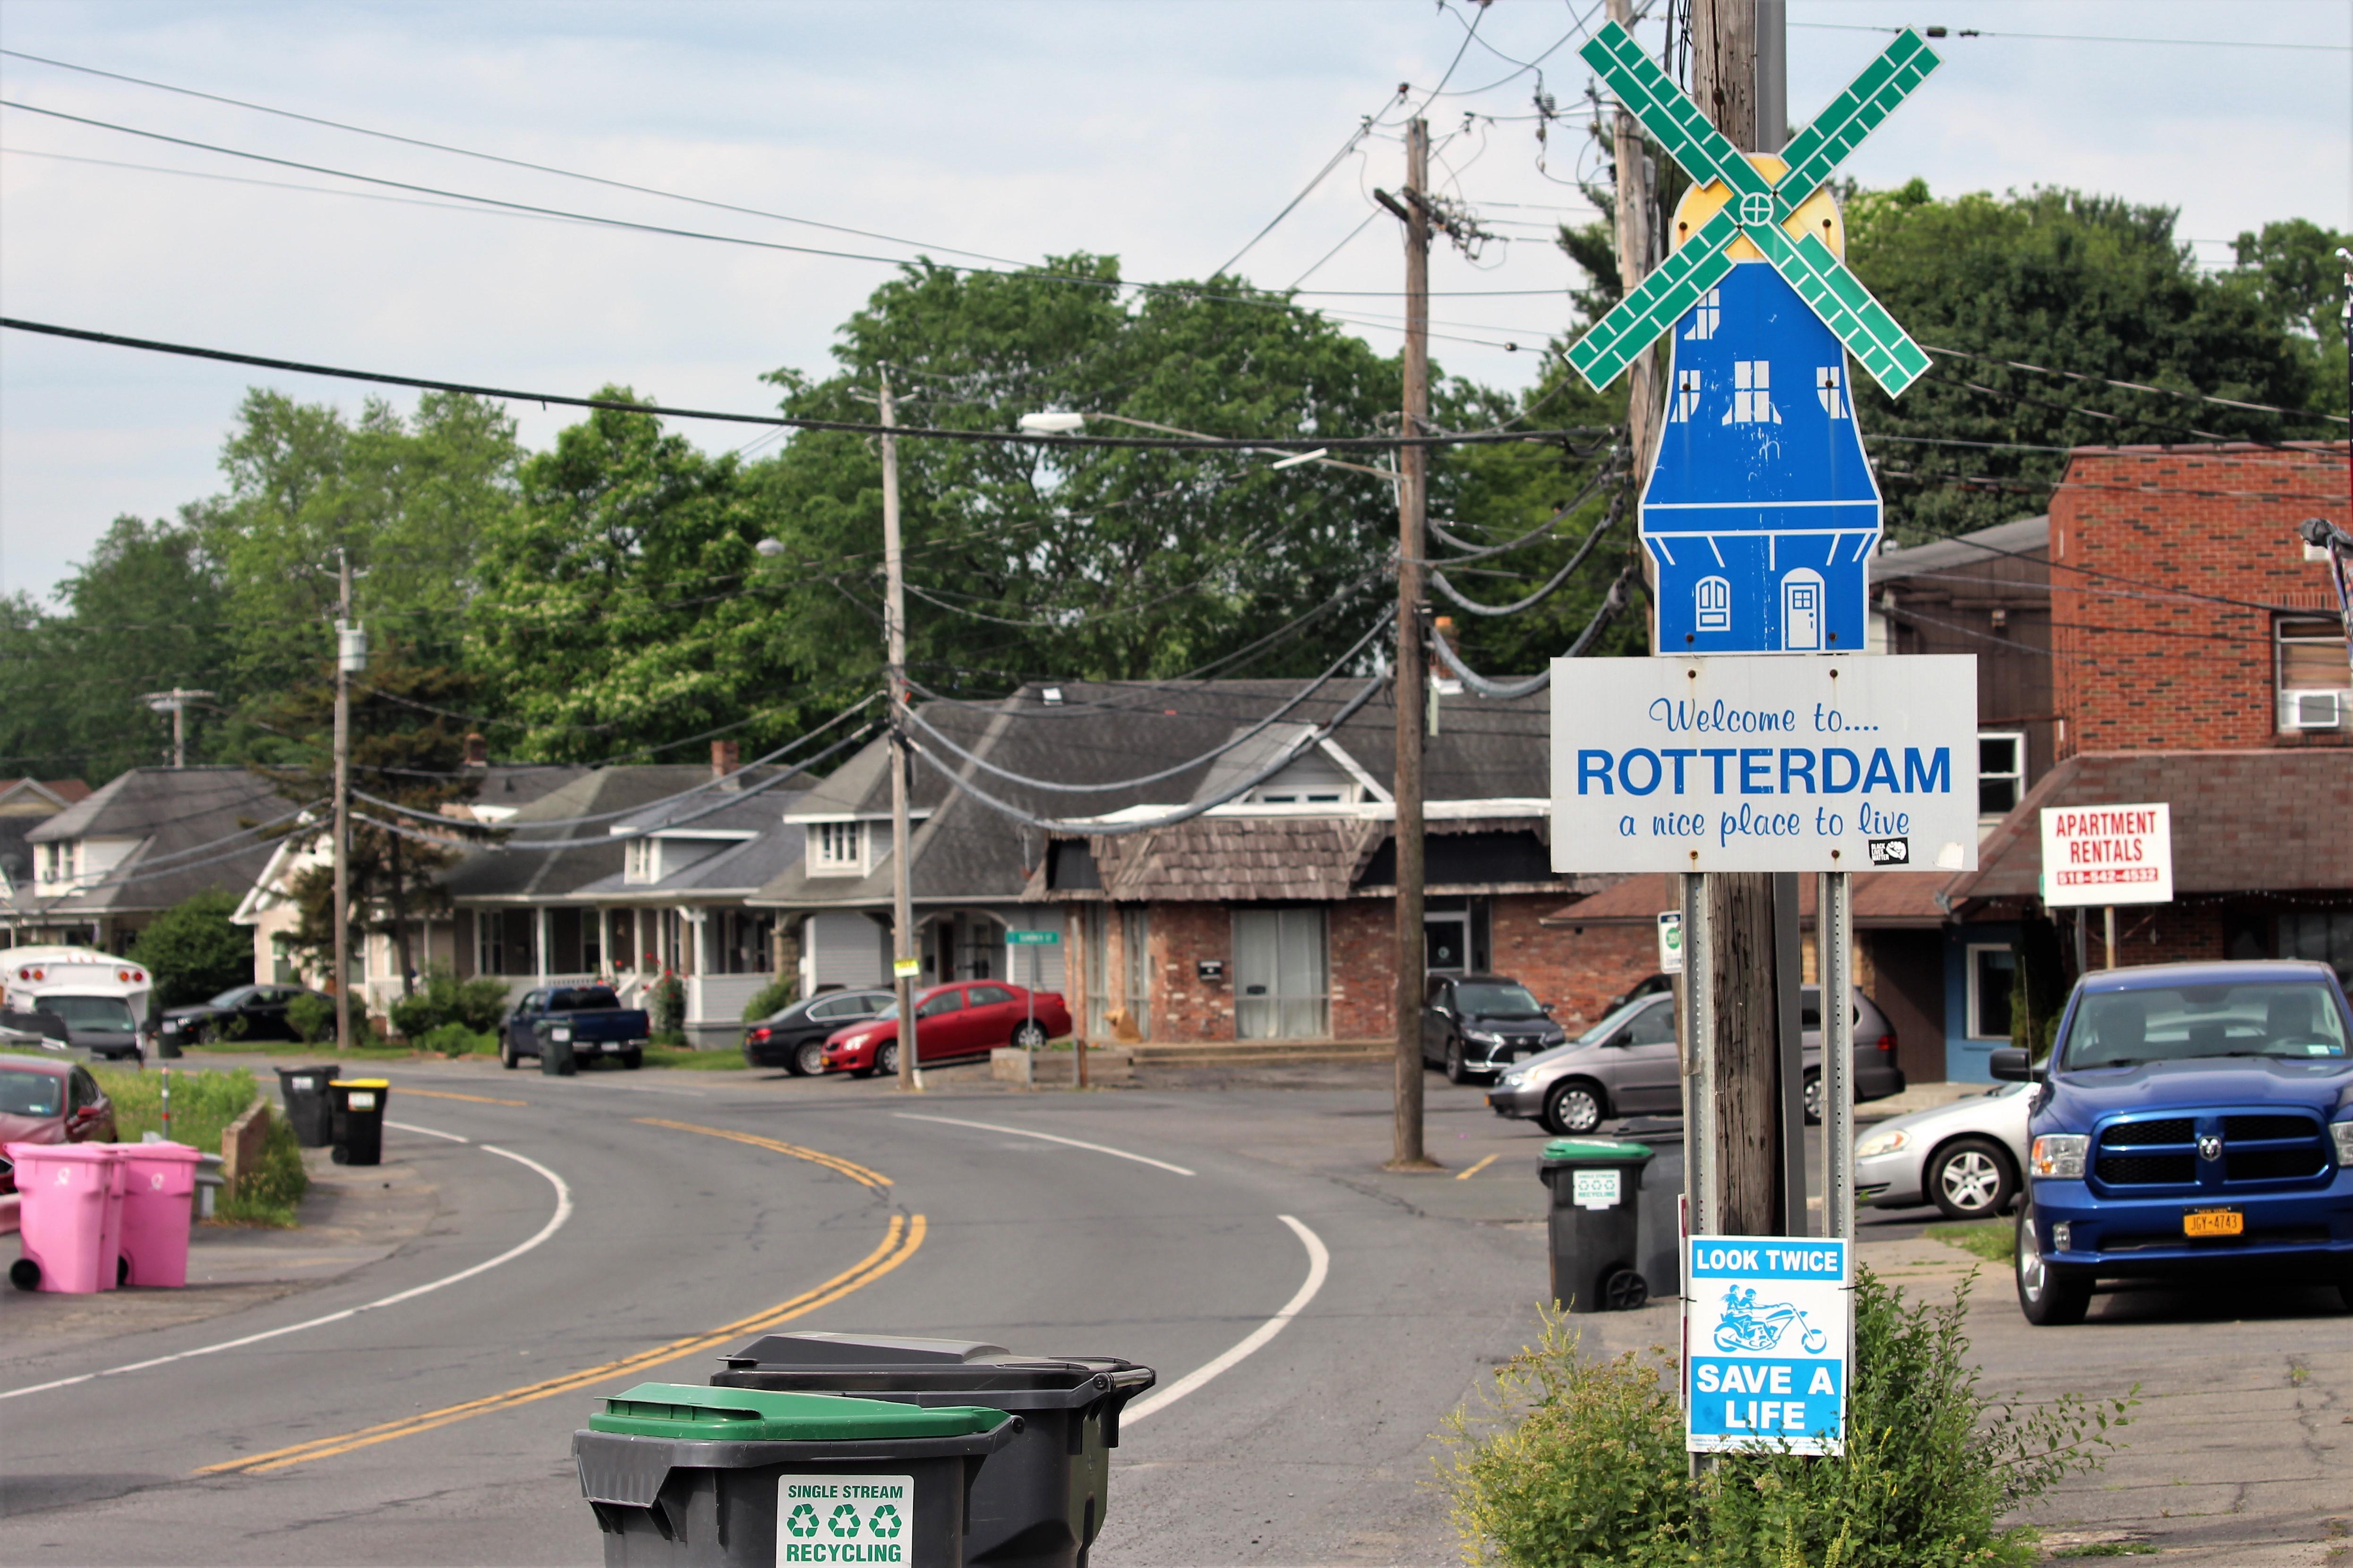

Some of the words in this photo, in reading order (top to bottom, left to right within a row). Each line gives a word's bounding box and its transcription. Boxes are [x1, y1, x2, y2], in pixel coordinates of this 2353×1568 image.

[1649, 698, 1795, 733] Welcome
[1577, 747, 1951, 796] ROTTERDAM
[1619, 815, 1635, 836] a
[1653, 812, 1705, 836] nice
[1720, 802, 1801, 847] place
[1816, 807, 1844, 835] to
[1858, 802, 1910, 835] live
[2056, 811, 2156, 836] APARTMENT
[2070, 838, 2142, 863] RENTALS
[1697, 1249, 1759, 1270] LOOK
[1765, 1250, 1838, 1272] TWICE
[1696, 1364, 1792, 1395] SAVE
[1807, 1367, 1835, 1395] A
[1725, 1400, 1805, 1430] LIFE
[788, 1485, 838, 1498] SINGLE
[843, 1485, 903, 1499] STREAM
[786, 1544, 901, 1563] RECYCLING
